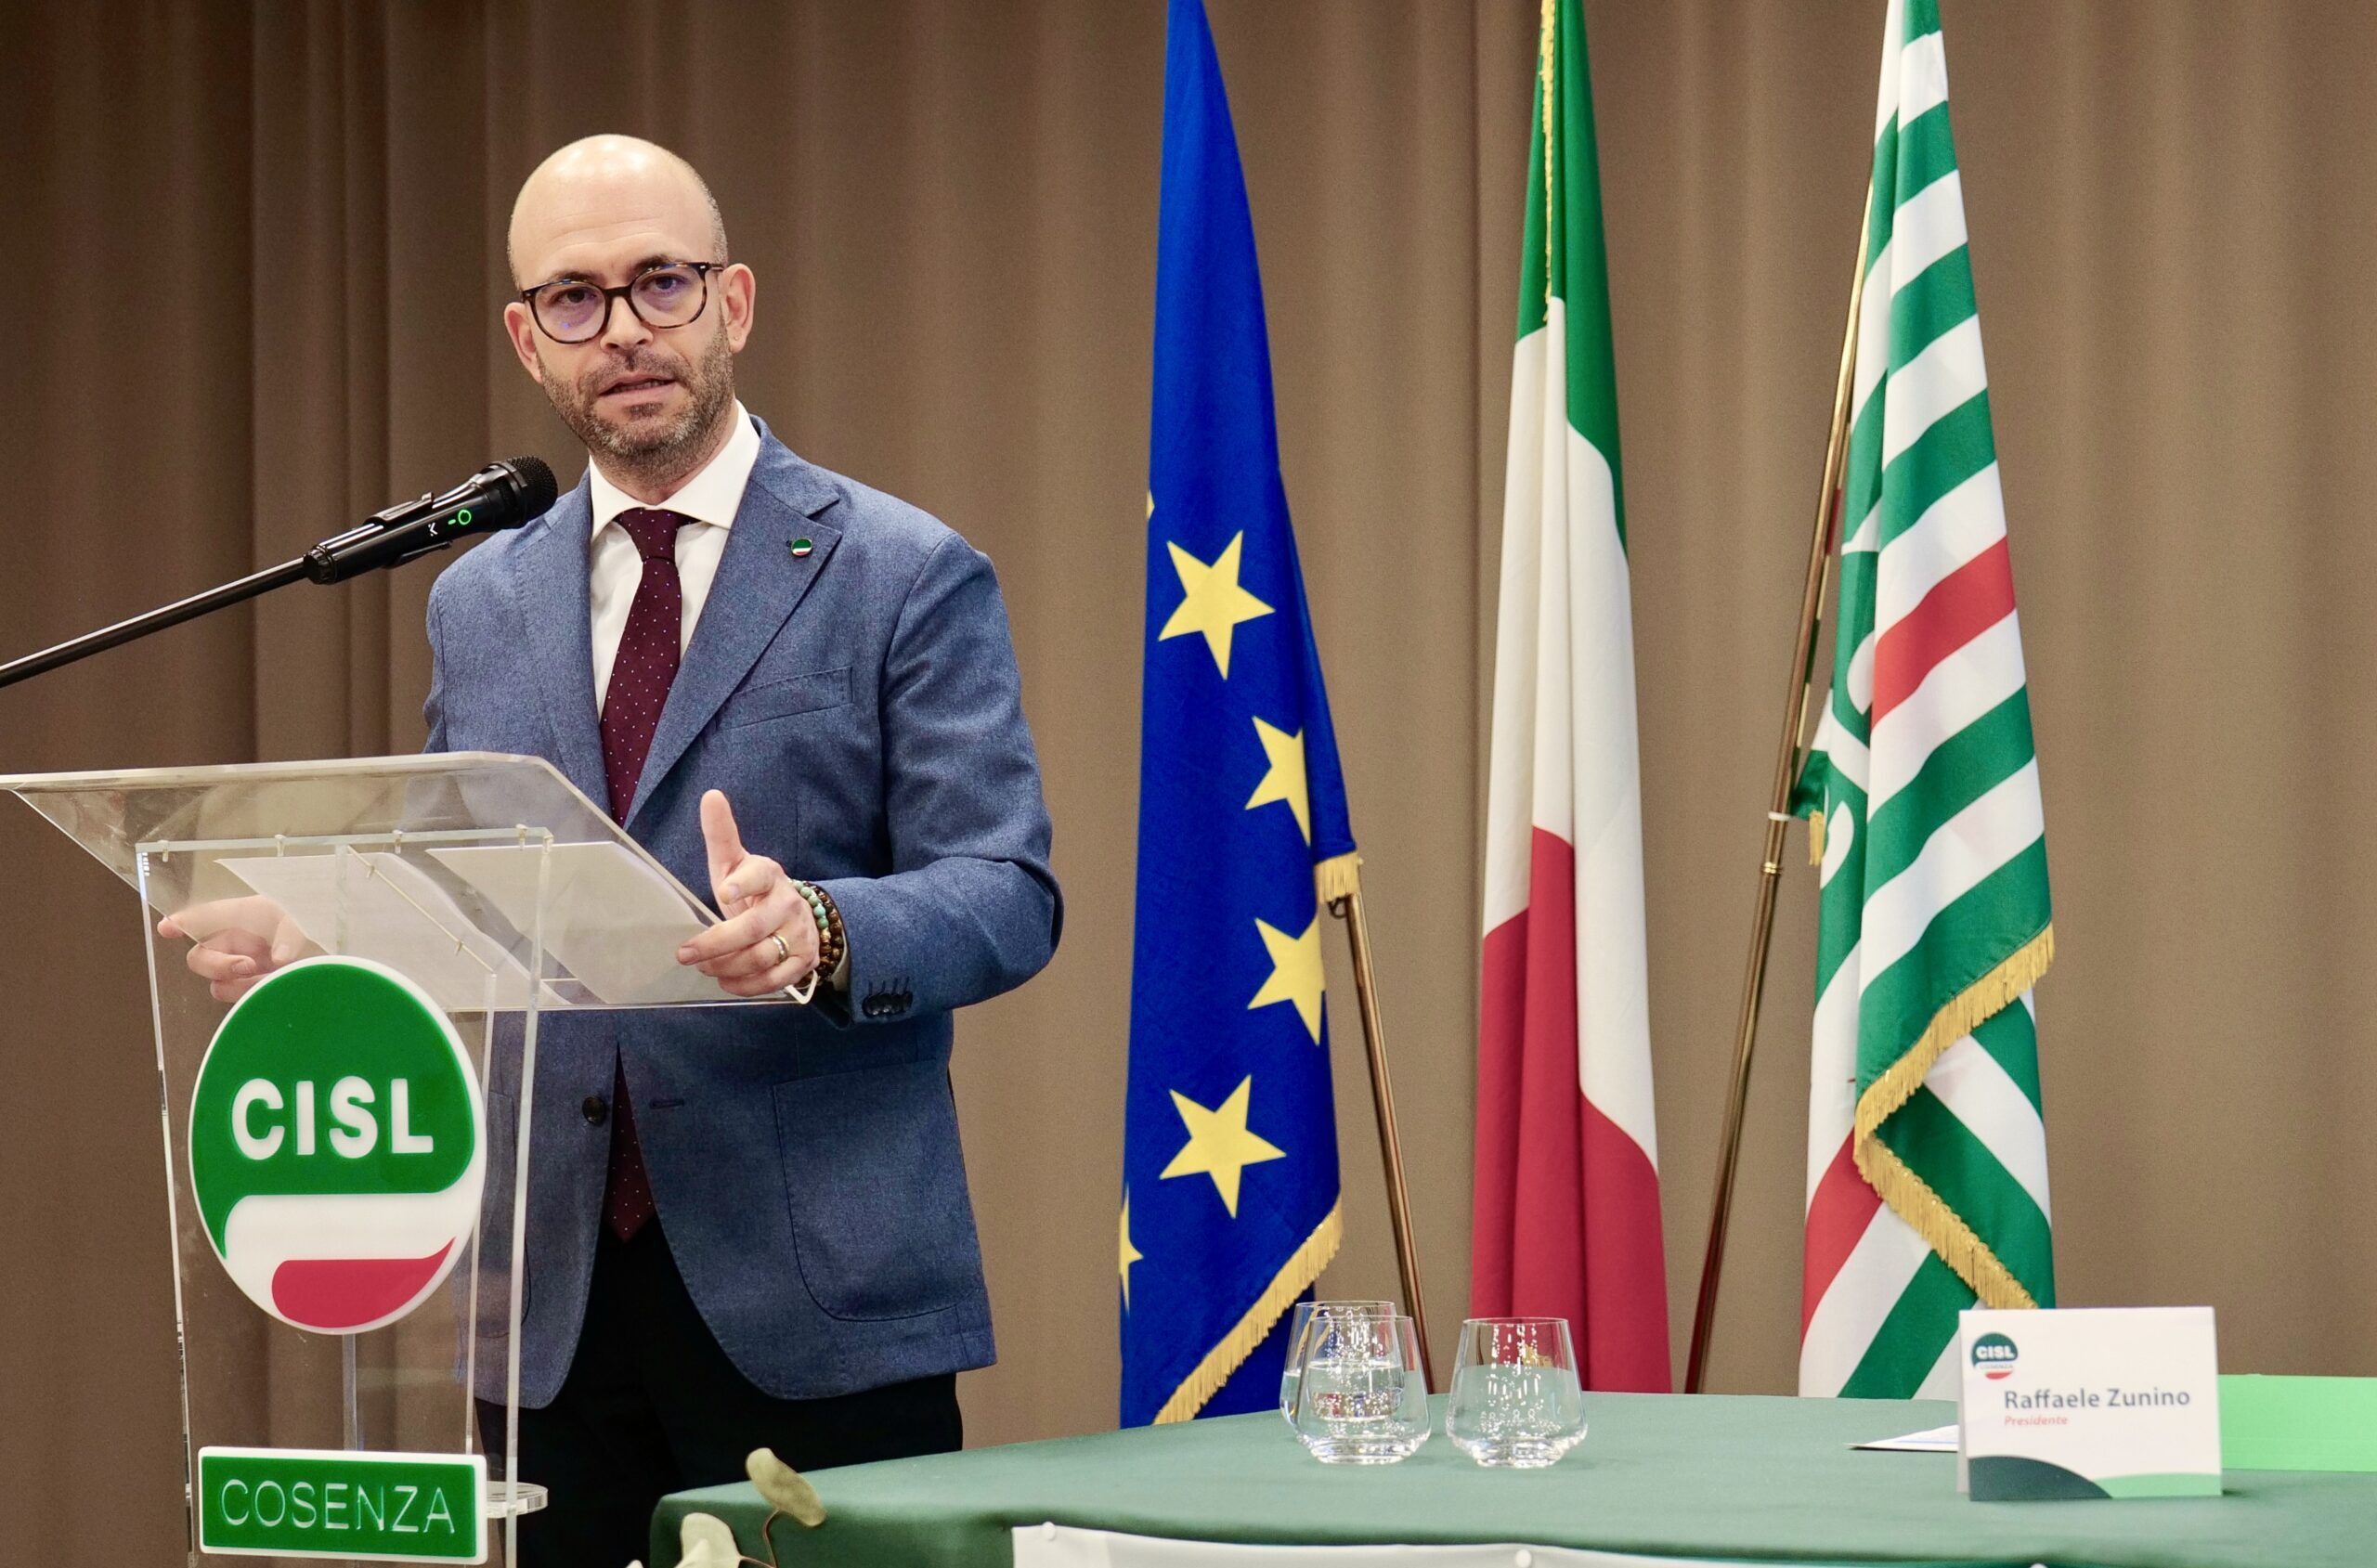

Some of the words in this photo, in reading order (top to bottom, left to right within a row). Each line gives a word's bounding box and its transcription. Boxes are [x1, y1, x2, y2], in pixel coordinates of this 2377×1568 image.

[231, 1076, 435, 1160] CISL
[1976, 1345, 2015, 1360] CISL
[2005, 1388, 2100, 1409] Raffaele
[2107, 1387, 2190, 1407] Zunino
[2004, 1415, 2068, 1426] Presidente
[221, 1479, 456, 1534] COSENZA
